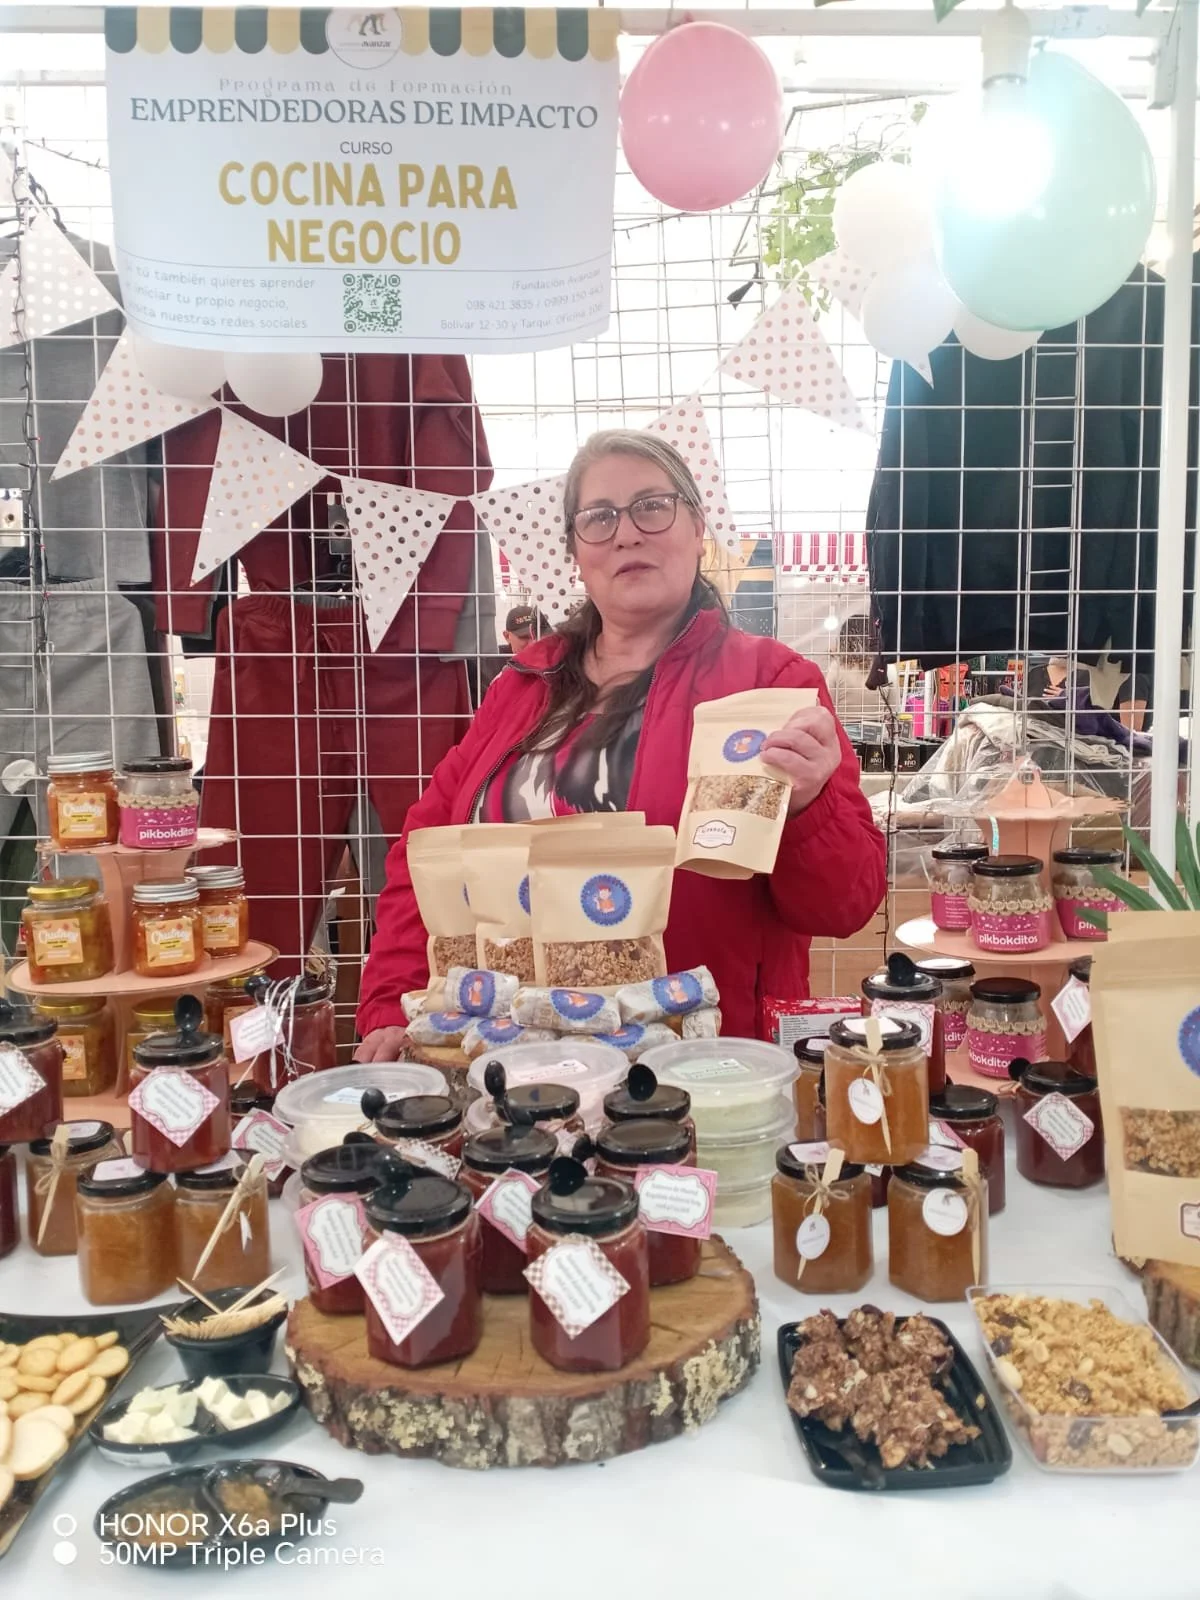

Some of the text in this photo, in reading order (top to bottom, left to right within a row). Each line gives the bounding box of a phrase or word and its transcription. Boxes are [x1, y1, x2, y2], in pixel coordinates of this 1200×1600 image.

[218, 76, 513, 98] Programa de Formación
[130, 97, 599, 129] EMPRENDEDORAS DE IMPACTO
[339, 140, 393, 156] CURSO
[217, 160, 519, 210] COCINA PARA
[266, 218, 462, 266] NEGOCIO
[154, 268, 206, 286] también
[210, 276, 256, 292] quieres
[259, 277, 316, 290] aprender
[177, 291, 191, 305] tu
[195, 295, 236, 312] propio
[239, 296, 289, 312] negocio,
[161, 310, 217, 327] nuestras
[221, 316, 256, 329] redes
[259, 316, 308, 329] sociales
[978, 933, 1039, 945] pikbokditos
